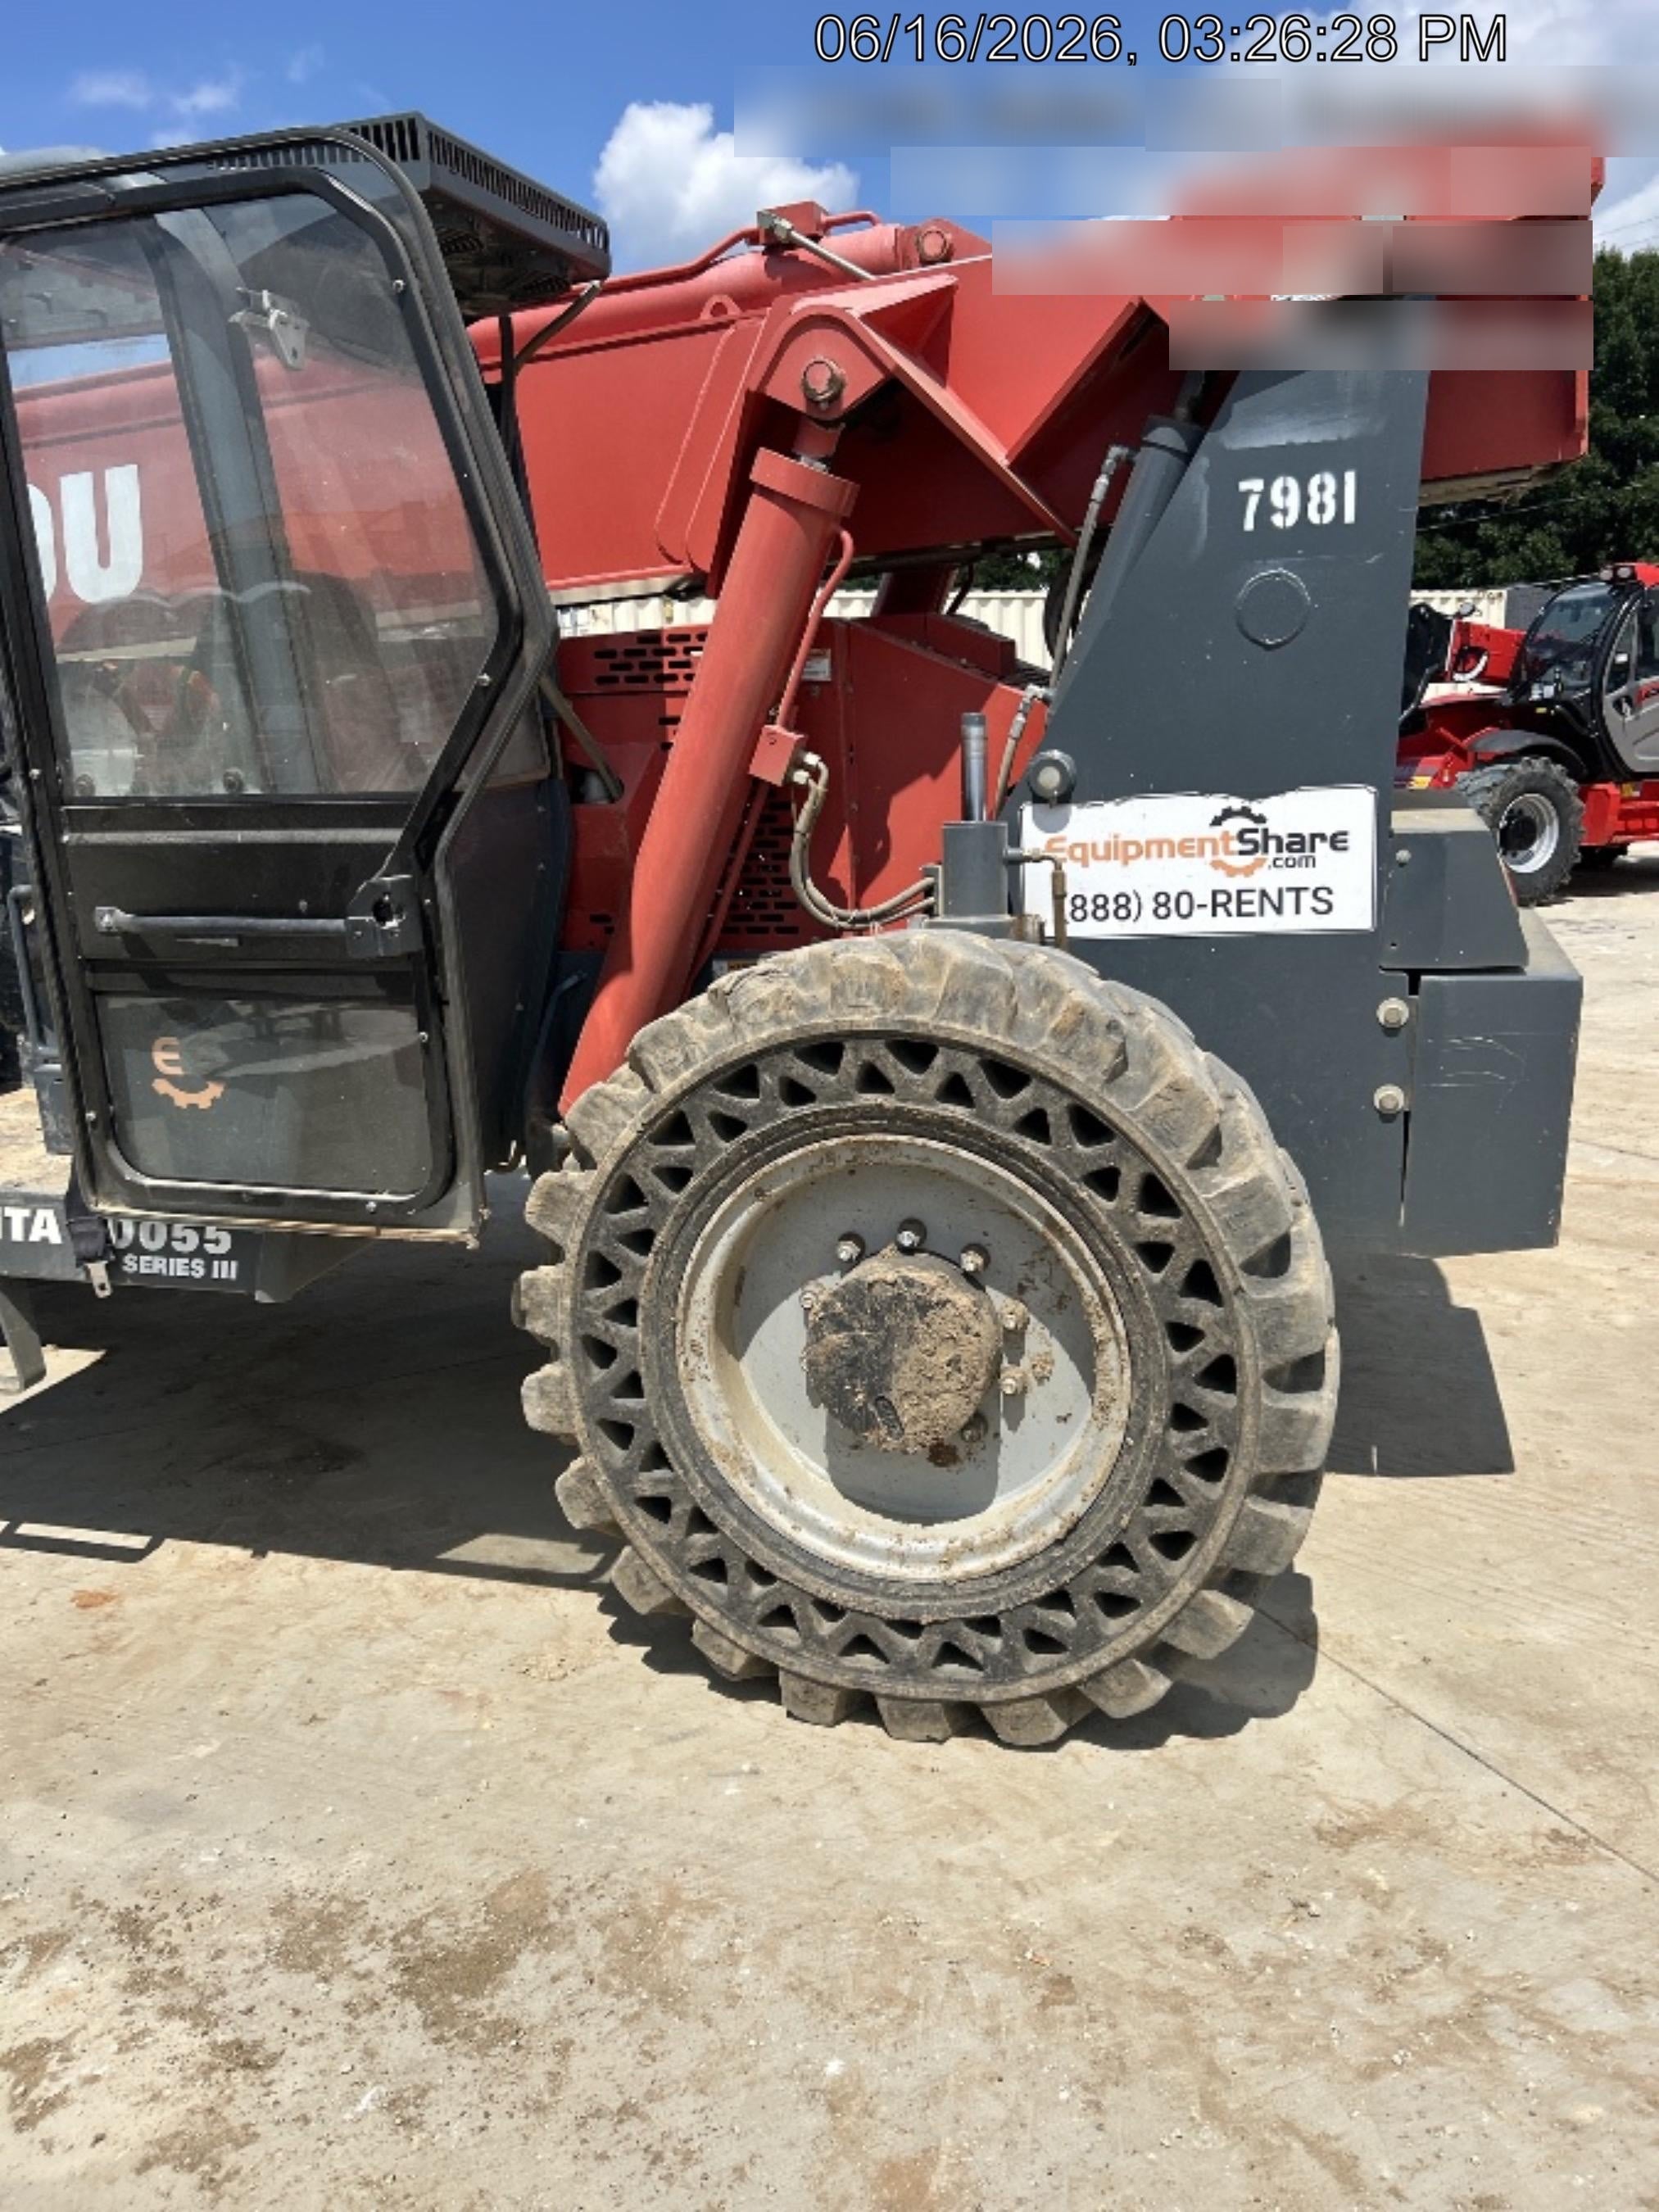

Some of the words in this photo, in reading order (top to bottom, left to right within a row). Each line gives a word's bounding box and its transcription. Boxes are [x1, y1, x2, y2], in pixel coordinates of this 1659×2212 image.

[1238, 469, 1357, 532] 7981
[1267, 853, 1317, 870] .com
[1151, 886, 1335, 919] 80-RENTS
[0, 1206, 62, 1244] TA
[123, 1253, 206, 1279] SERIES
